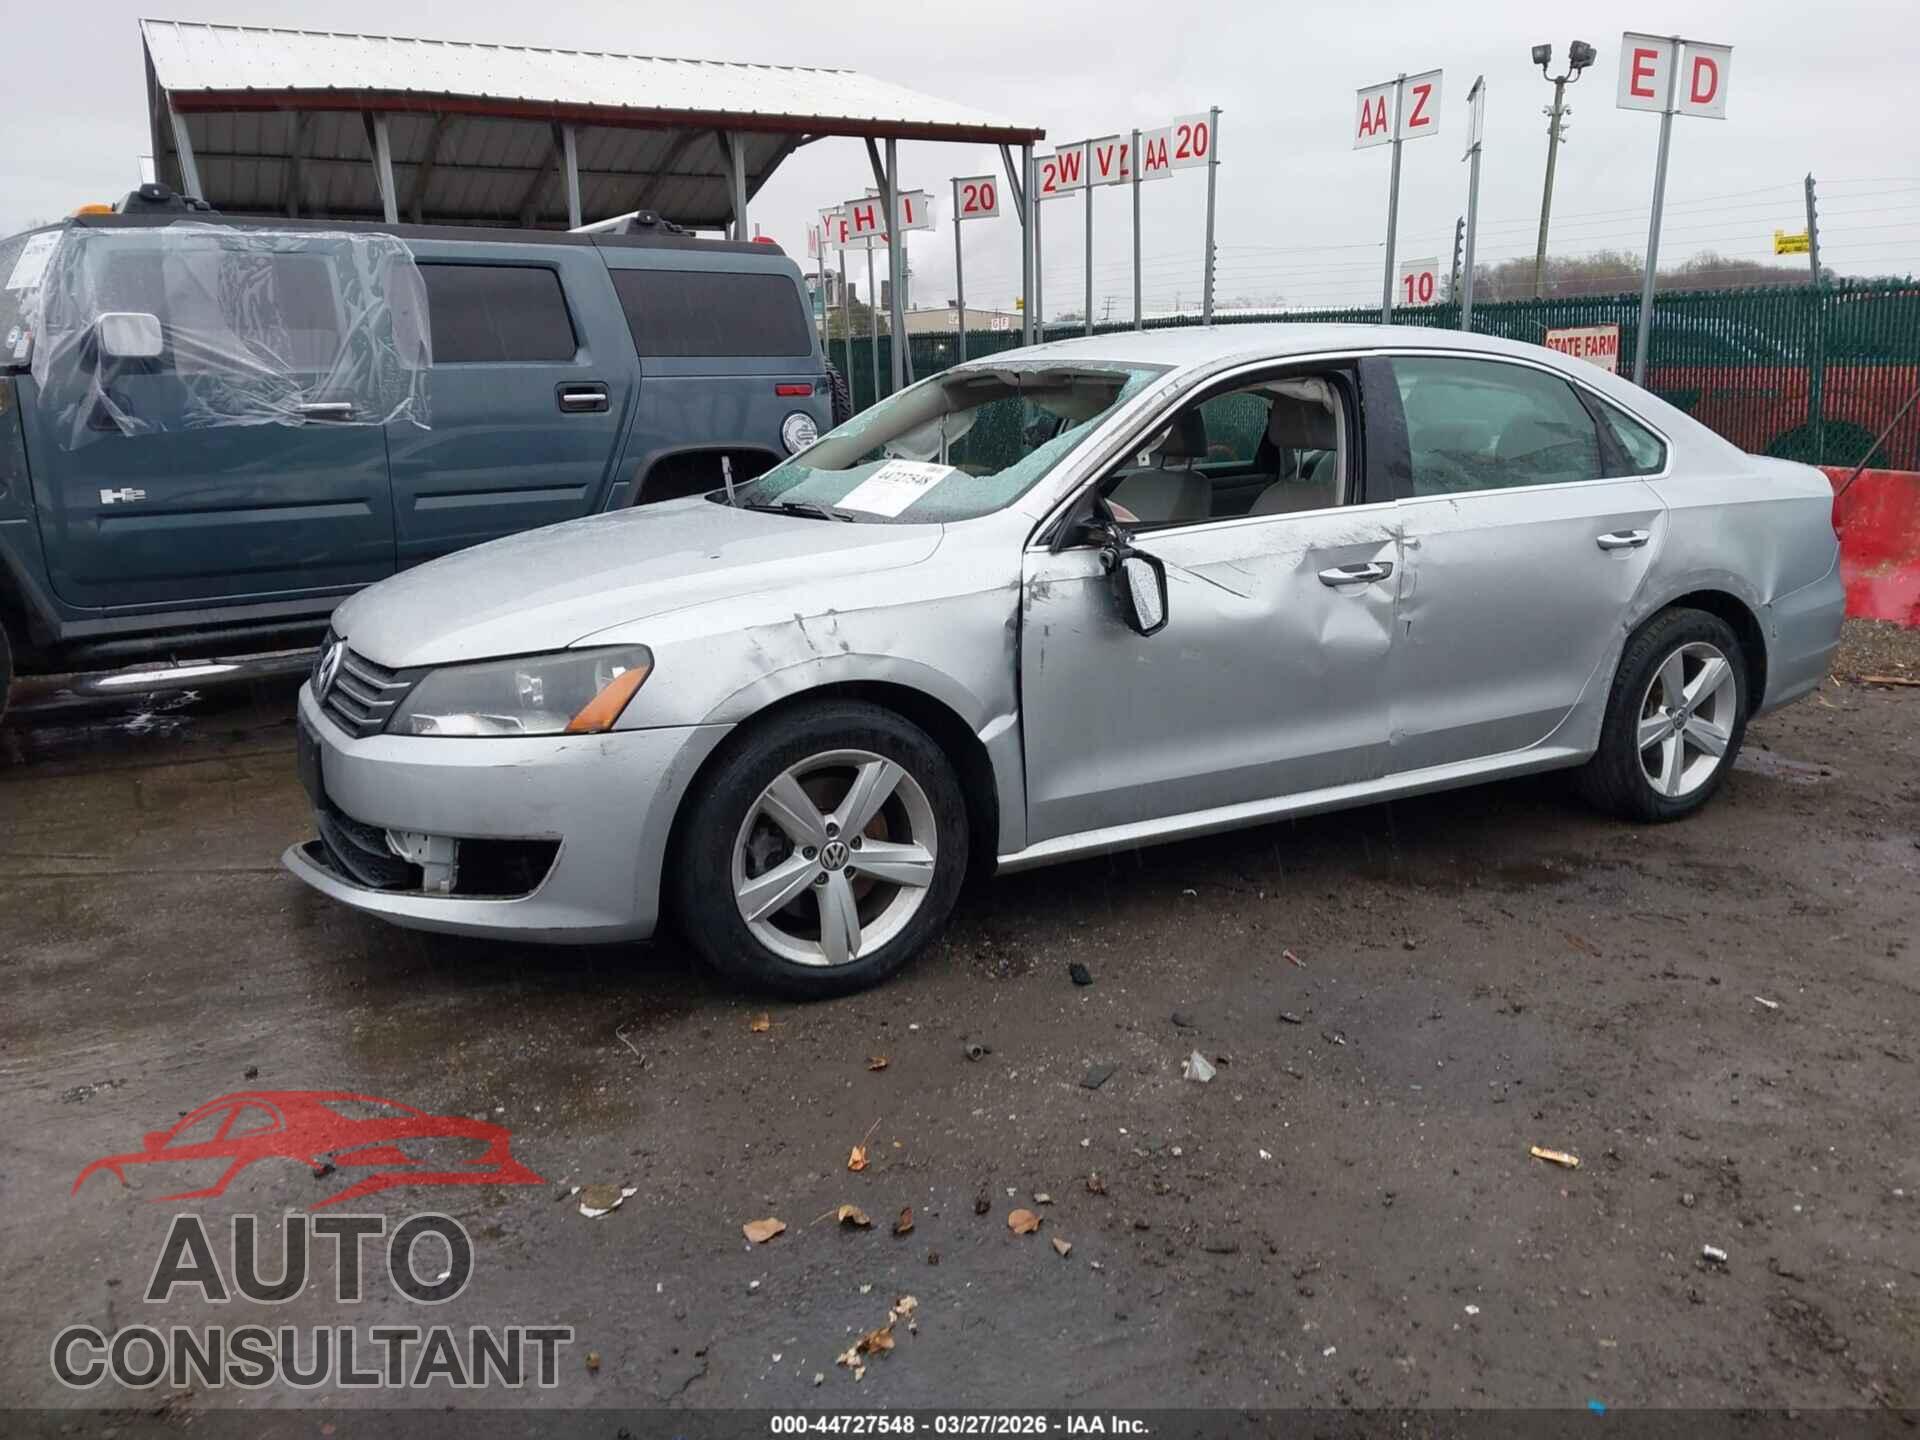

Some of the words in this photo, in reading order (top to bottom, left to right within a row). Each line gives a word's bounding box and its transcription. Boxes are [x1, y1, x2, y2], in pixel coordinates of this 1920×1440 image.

[1630, 47, 1658, 98] E
[1690, 56, 1718, 104] D
[1358, 95, 1387, 138] AA
[1409, 83, 1432, 127] Z
[1145, 137, 1169, 171] AA
[1176, 122, 1208, 159] 20
[1058, 150, 1081, 183] W
[1097, 144, 1114, 177] V
[963, 183, 995, 212] 20
[854, 205, 876, 232] H
[1404, 271, 1433, 304] 10
[1547, 336, 1581, 358] STATE
[1584, 334, 1617, 357] FARM
